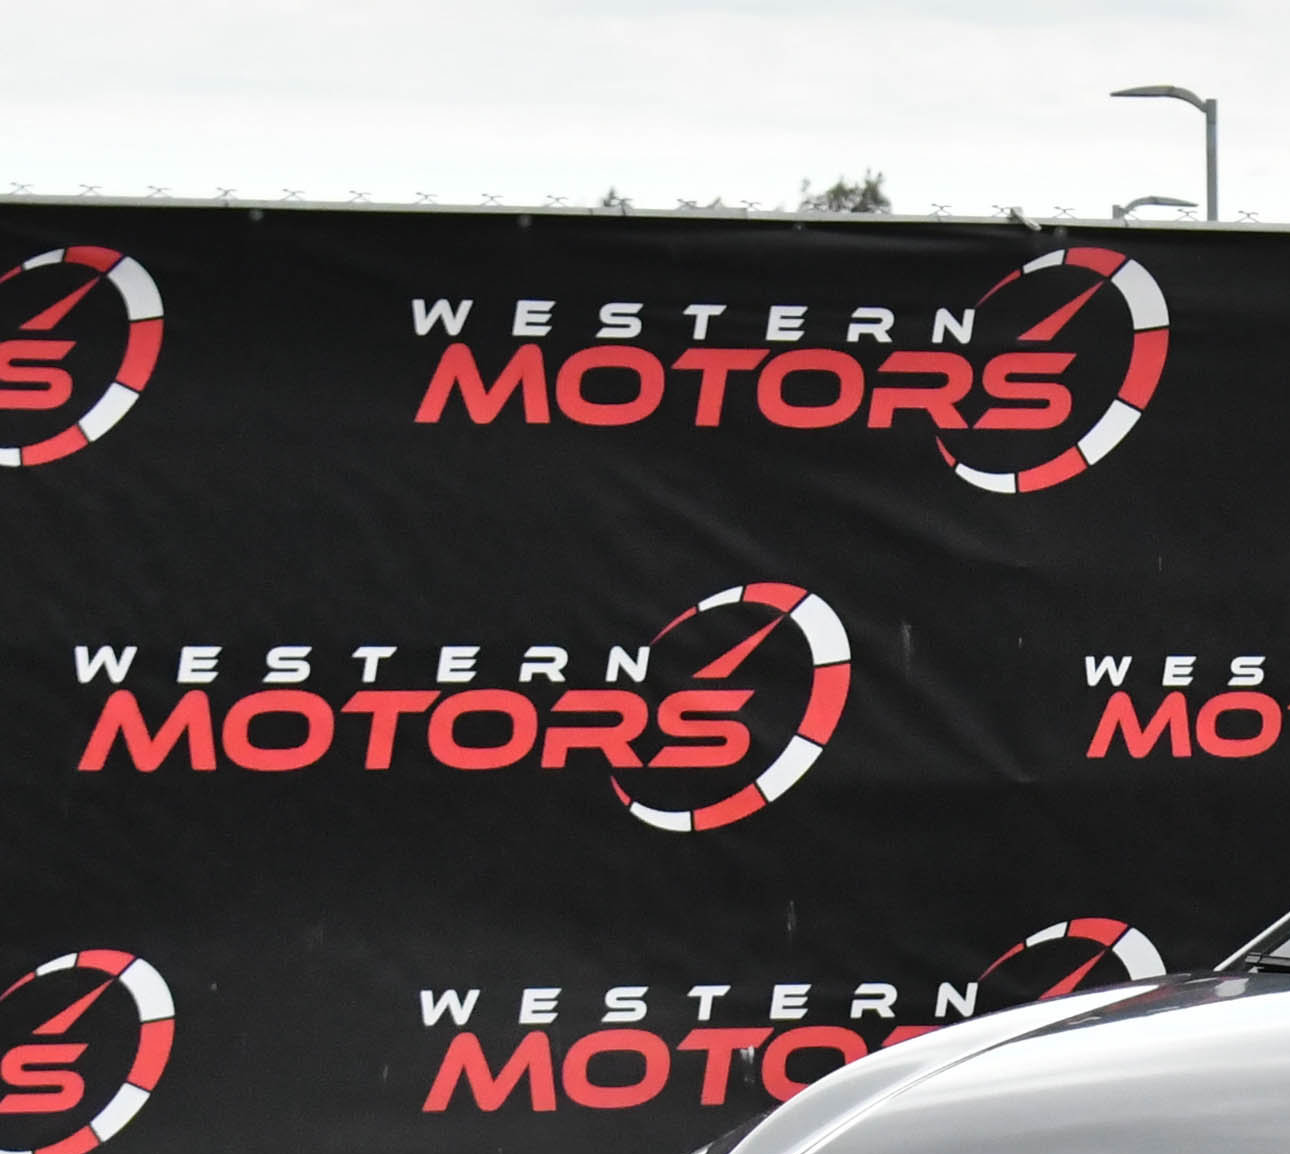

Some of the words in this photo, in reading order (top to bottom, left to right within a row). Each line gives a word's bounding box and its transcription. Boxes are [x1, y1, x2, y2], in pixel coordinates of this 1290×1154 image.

[412, 299, 976, 344] WESTERN
[415, 342, 1077, 430] MOTORS
[74, 645, 651, 684] WESTERN
[77, 688, 755, 773] MOTORS
[420, 982, 979, 1027] WESTERN
